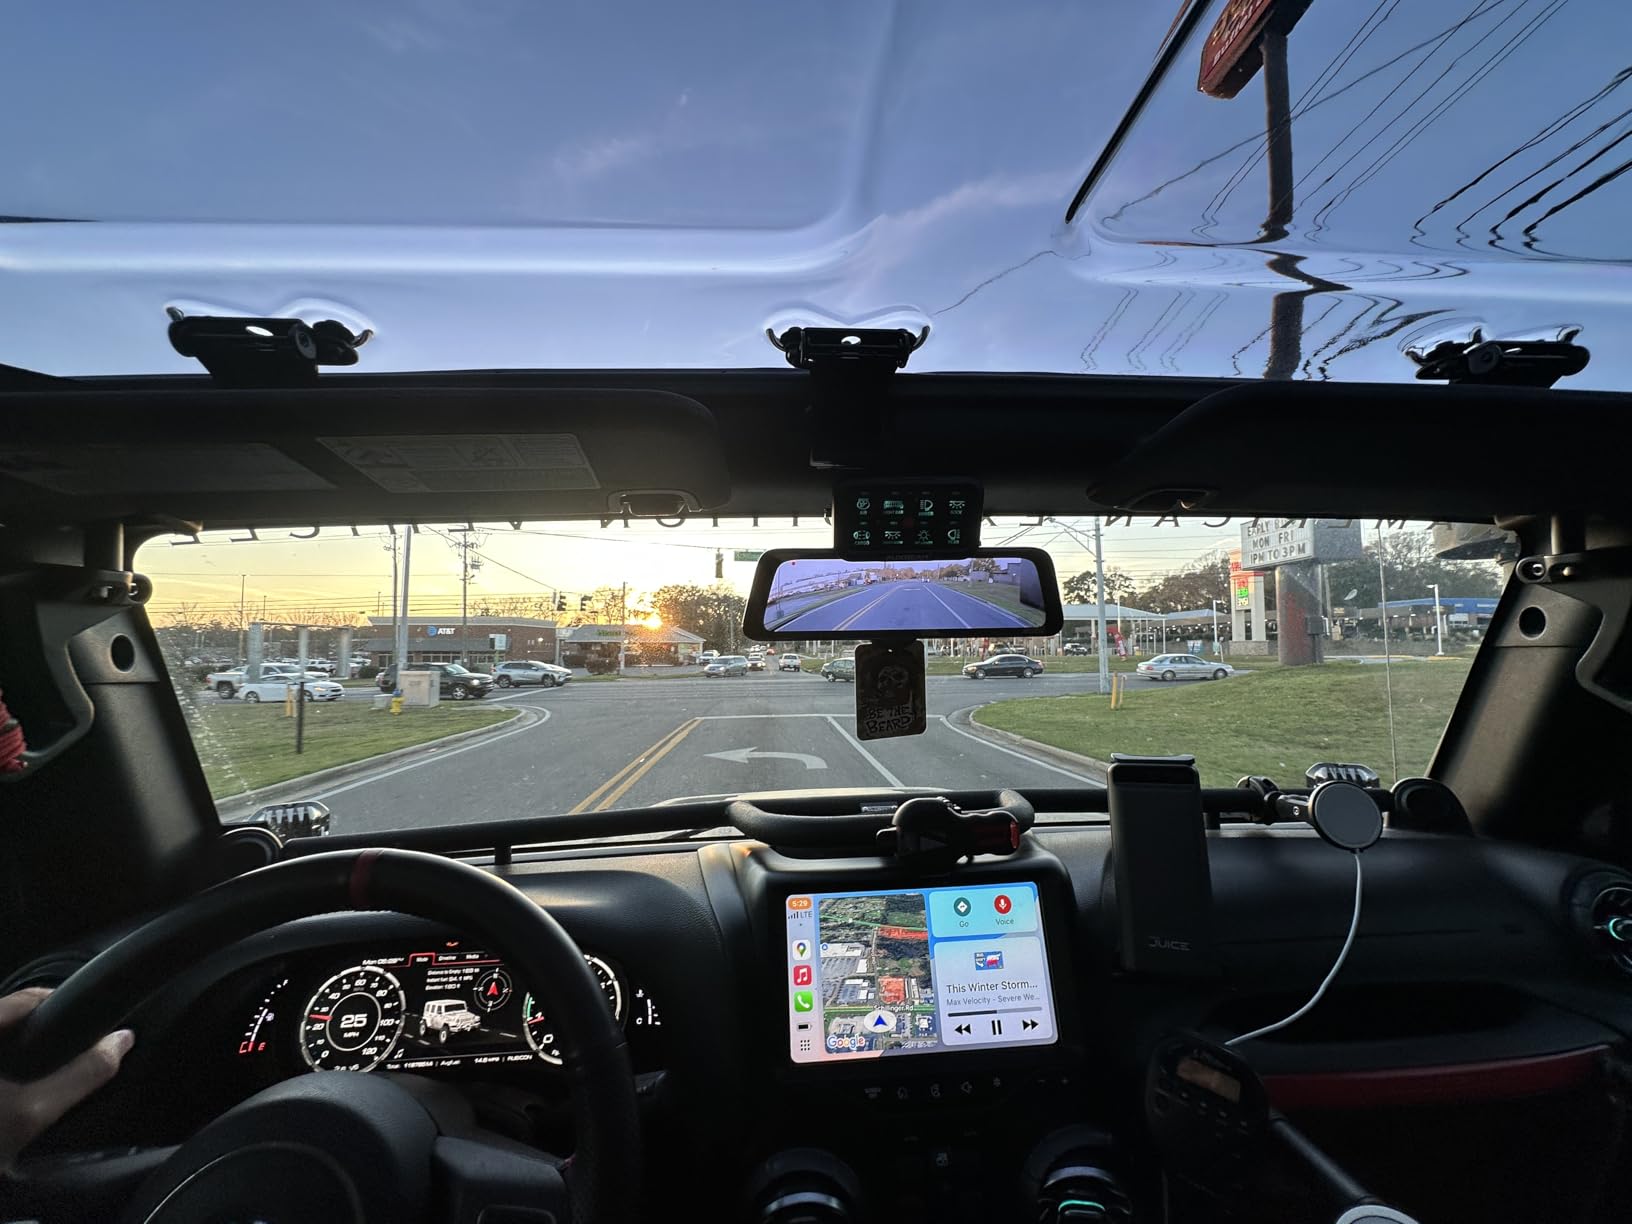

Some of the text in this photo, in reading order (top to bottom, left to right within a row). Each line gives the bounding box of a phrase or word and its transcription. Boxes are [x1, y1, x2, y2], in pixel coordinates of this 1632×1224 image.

[1253, 530, 1294, 549] MON FRI
[1268, 549, 1280, 560] TO
[437, 627, 456, 635] AT&T
[866, 716, 911, 733] BEARD
[1148, 936, 1191, 950] JUICE
[947, 984, 966, 993] This
[968, 981, 998, 991] Winter
[963, 996, 990, 1004] Velocity
[997, 994, 1021, 1003] Severe
[340, 1013, 368, 1028] 25
[827, 1034, 865, 1049] Google
